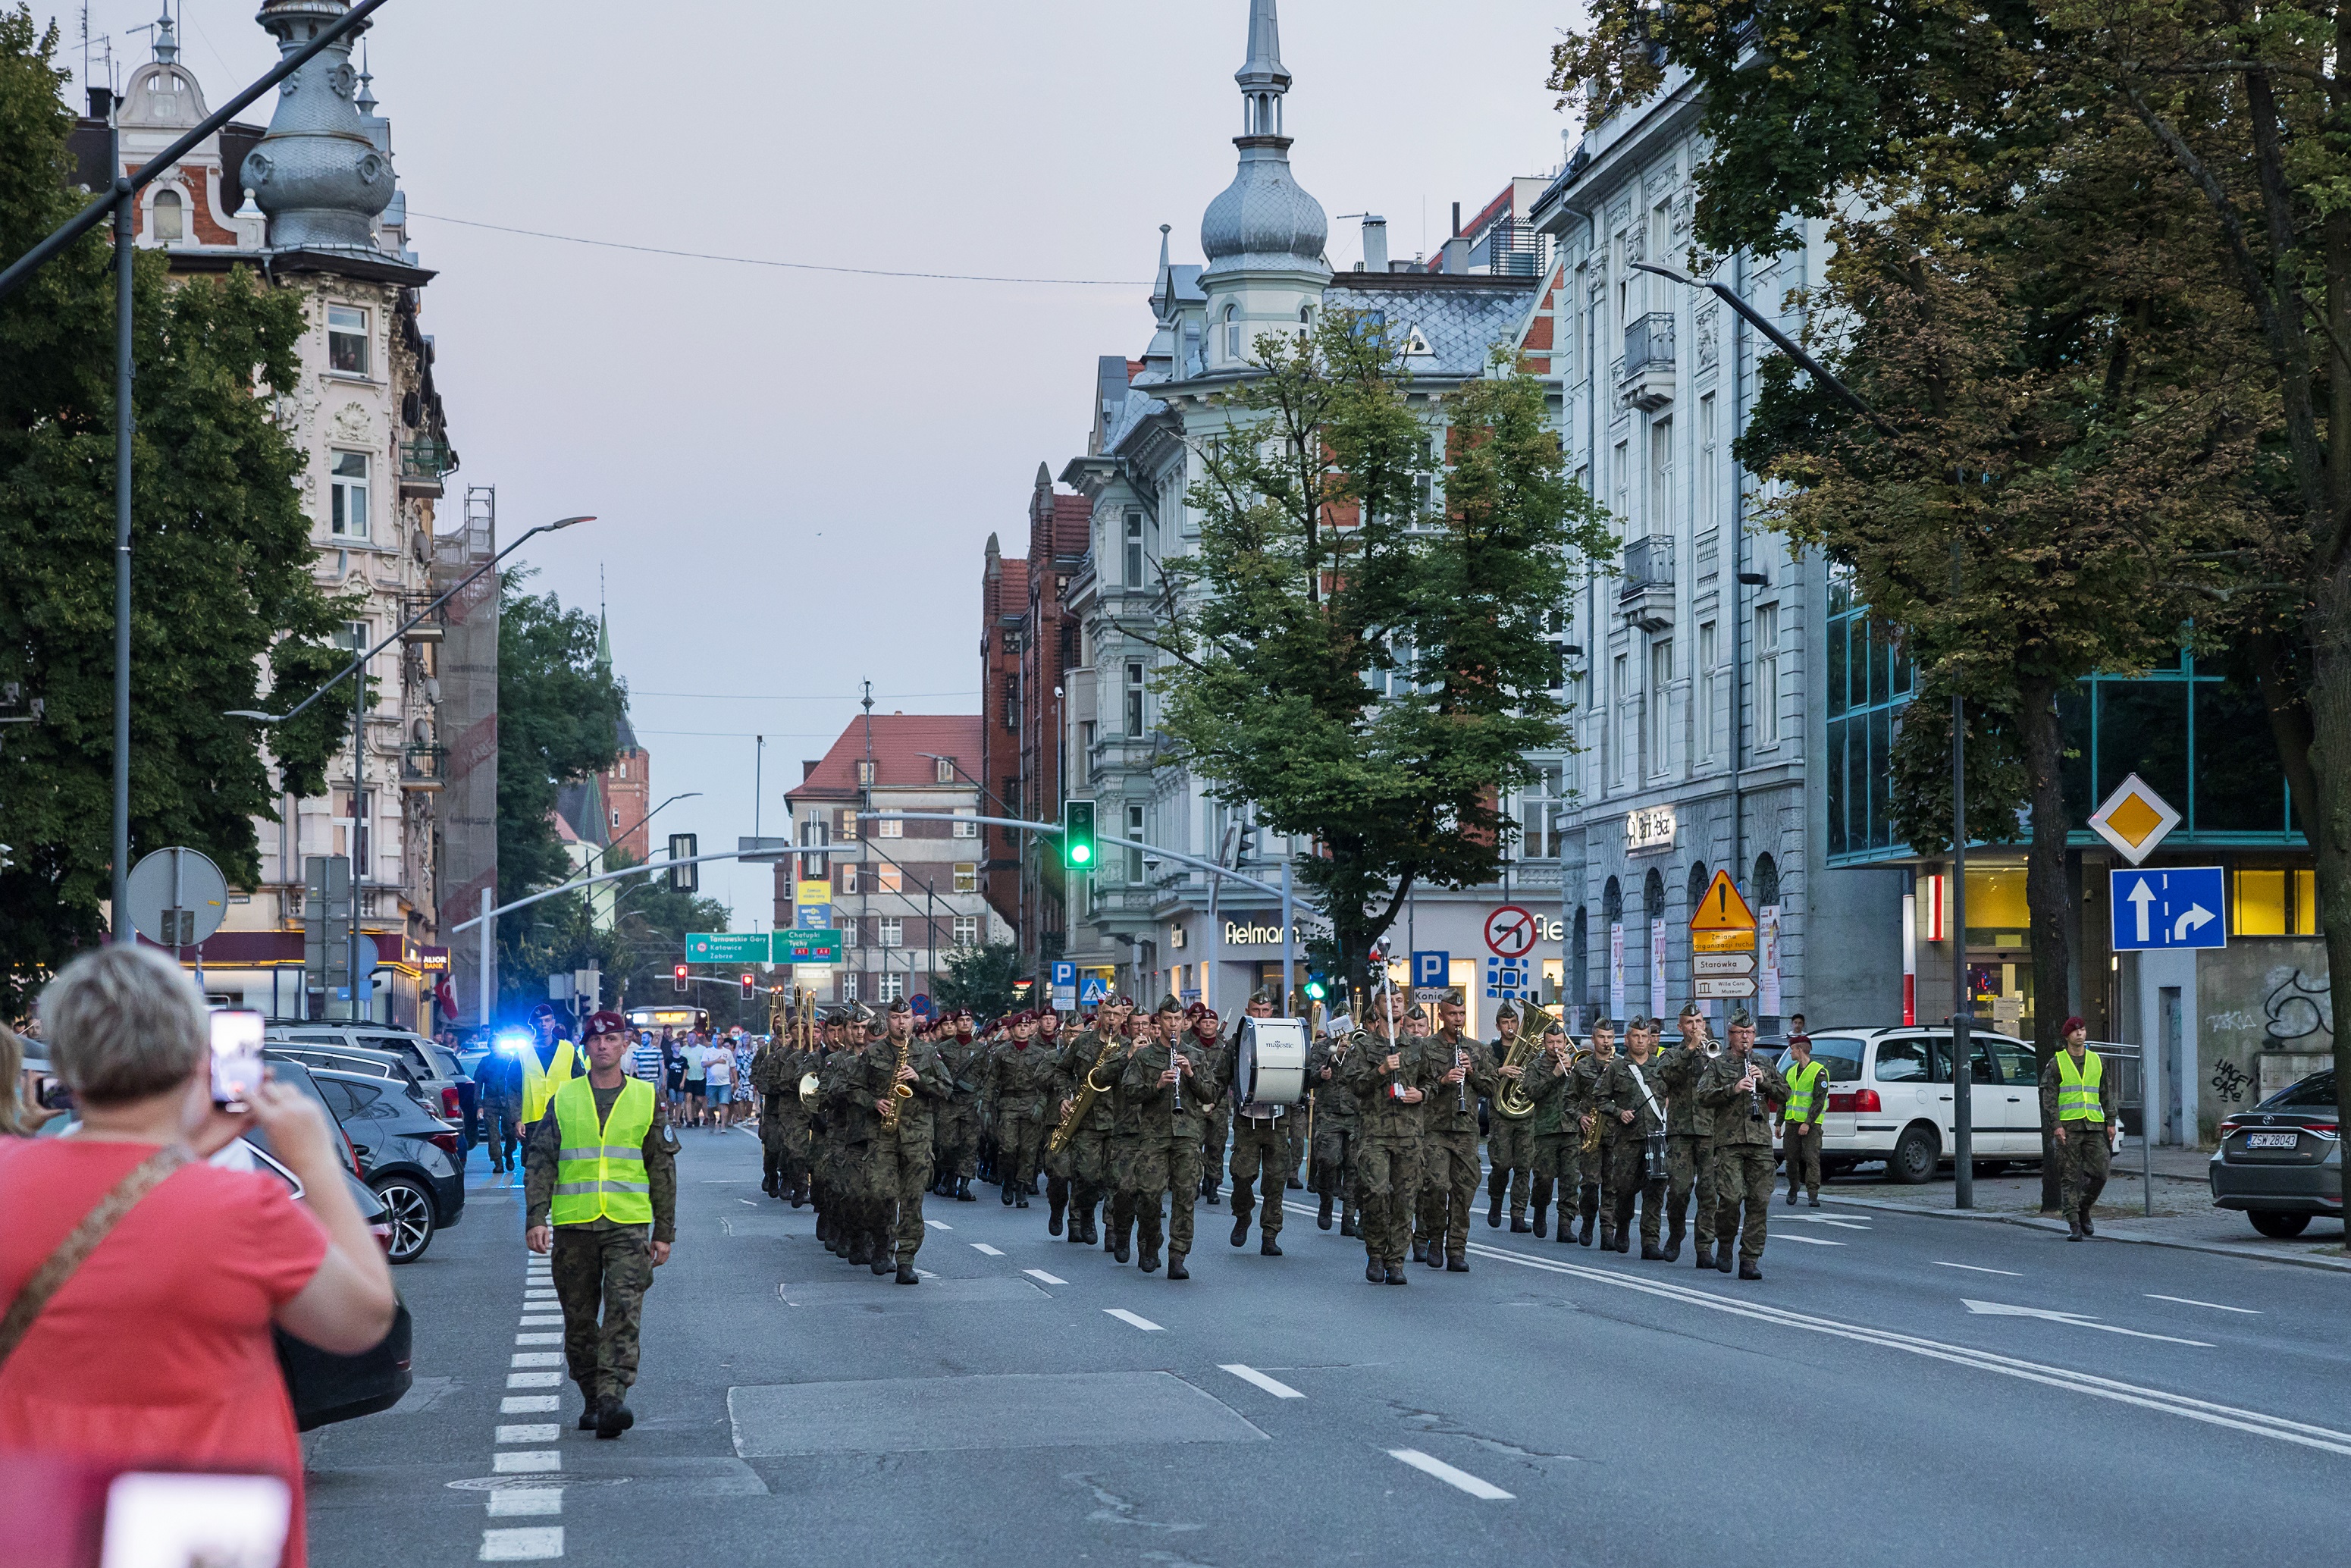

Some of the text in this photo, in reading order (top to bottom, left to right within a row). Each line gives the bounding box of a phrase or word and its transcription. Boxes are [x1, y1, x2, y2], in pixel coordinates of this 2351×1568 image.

[1694, 942, 1733, 951] organizacji
[1057, 964, 1071, 983] P
[1422, 955, 1442, 983] P
[1265, 1041, 1294, 1050] majestic
[2251, 1134, 2296, 1146] ZSW 28043
